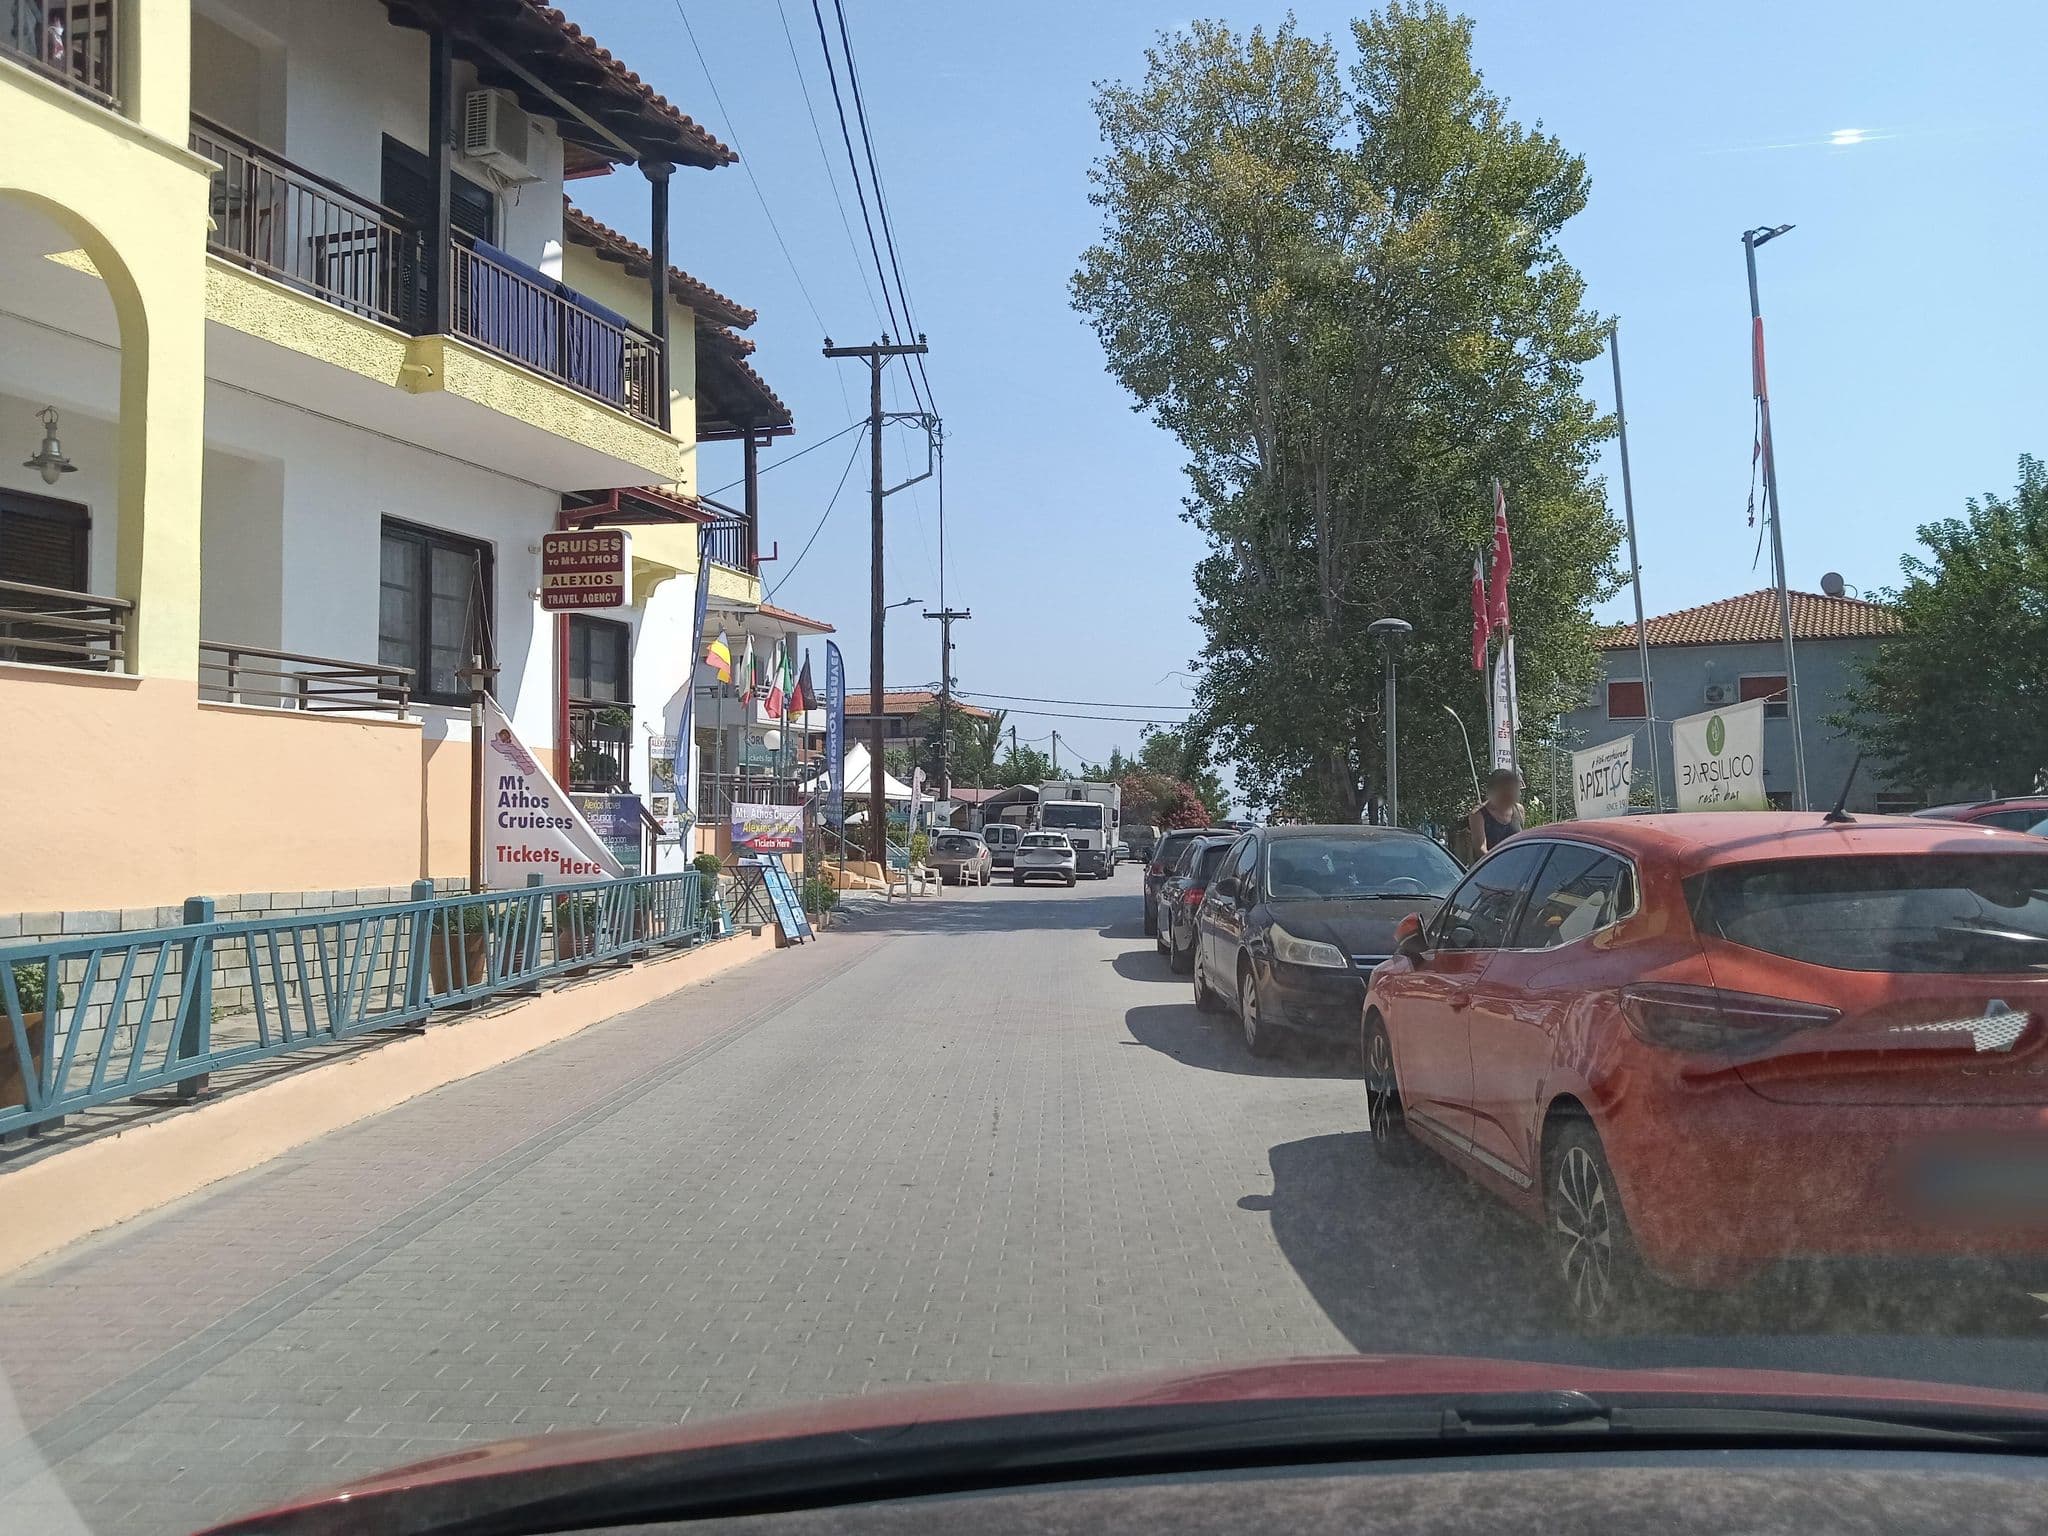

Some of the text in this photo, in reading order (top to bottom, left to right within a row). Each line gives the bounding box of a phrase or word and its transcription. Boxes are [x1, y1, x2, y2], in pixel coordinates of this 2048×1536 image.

[546, 538, 621, 554] CRUISES
[561, 556, 578, 566] Mt.
[580, 554, 619, 565] ATHOS
[550, 574, 614, 587] ALEXIOS
[547, 592, 617, 605] TRAVEL AGENCY
[1682, 754, 1754, 786] BARSILICO
[498, 775, 530, 791] Mt.
[498, 791, 550, 809] Athos
[750, 807, 773, 819] Athos
[498, 811, 573, 830] Cruieses
[742, 821, 771, 833] Alexios
[753, 838, 790, 848] Tickets Here
[496, 844, 602, 875] Tickets Here
